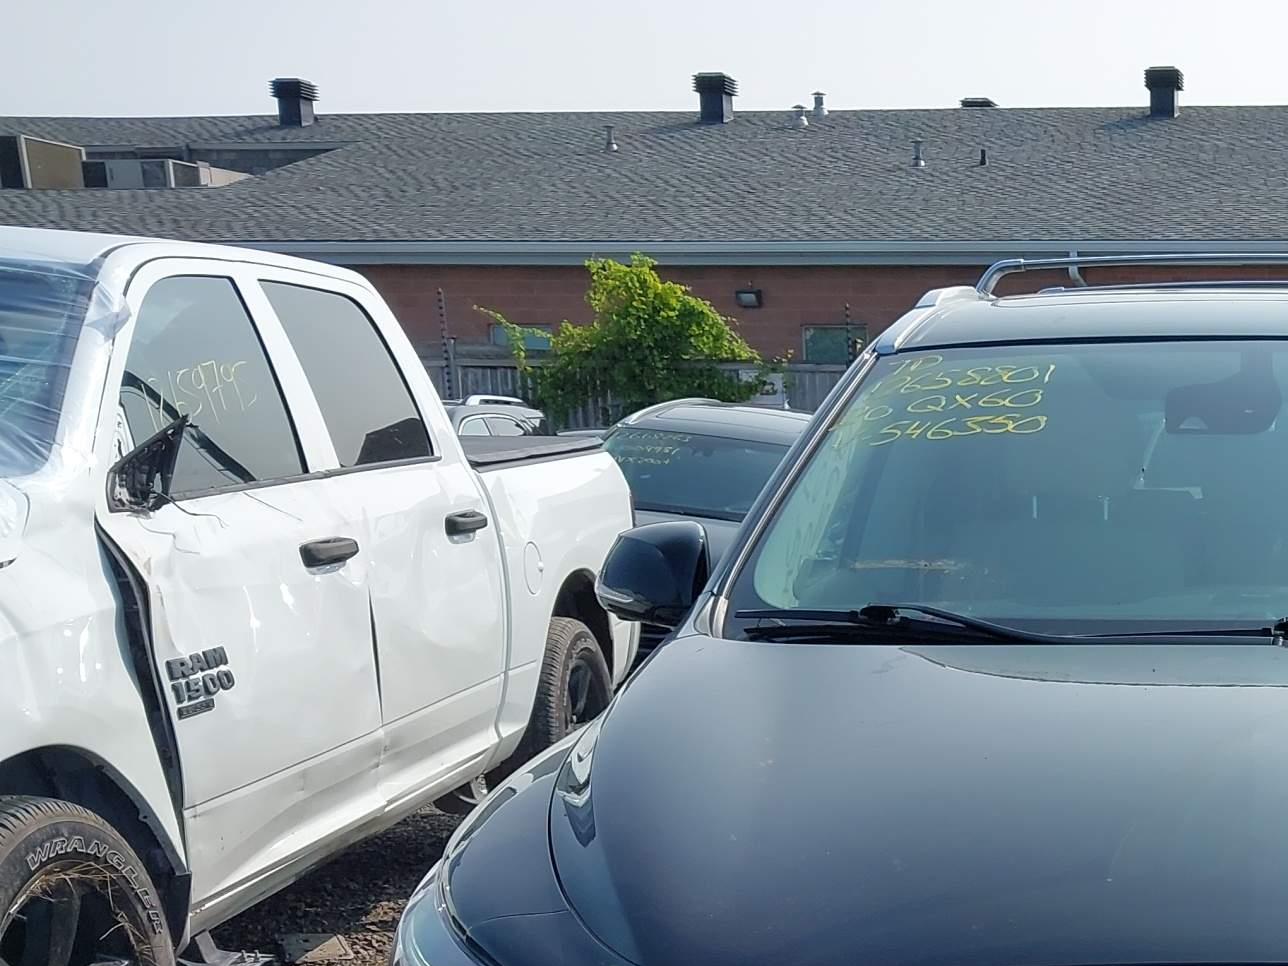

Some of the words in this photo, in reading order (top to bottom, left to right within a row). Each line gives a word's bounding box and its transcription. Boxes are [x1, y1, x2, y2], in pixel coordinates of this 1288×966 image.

[906, 389, 1045, 413] QX60
[165, 645, 229, 682] RAM
[171, 669, 235, 706] 1500
[24, 835, 165, 935] WRANGLER
